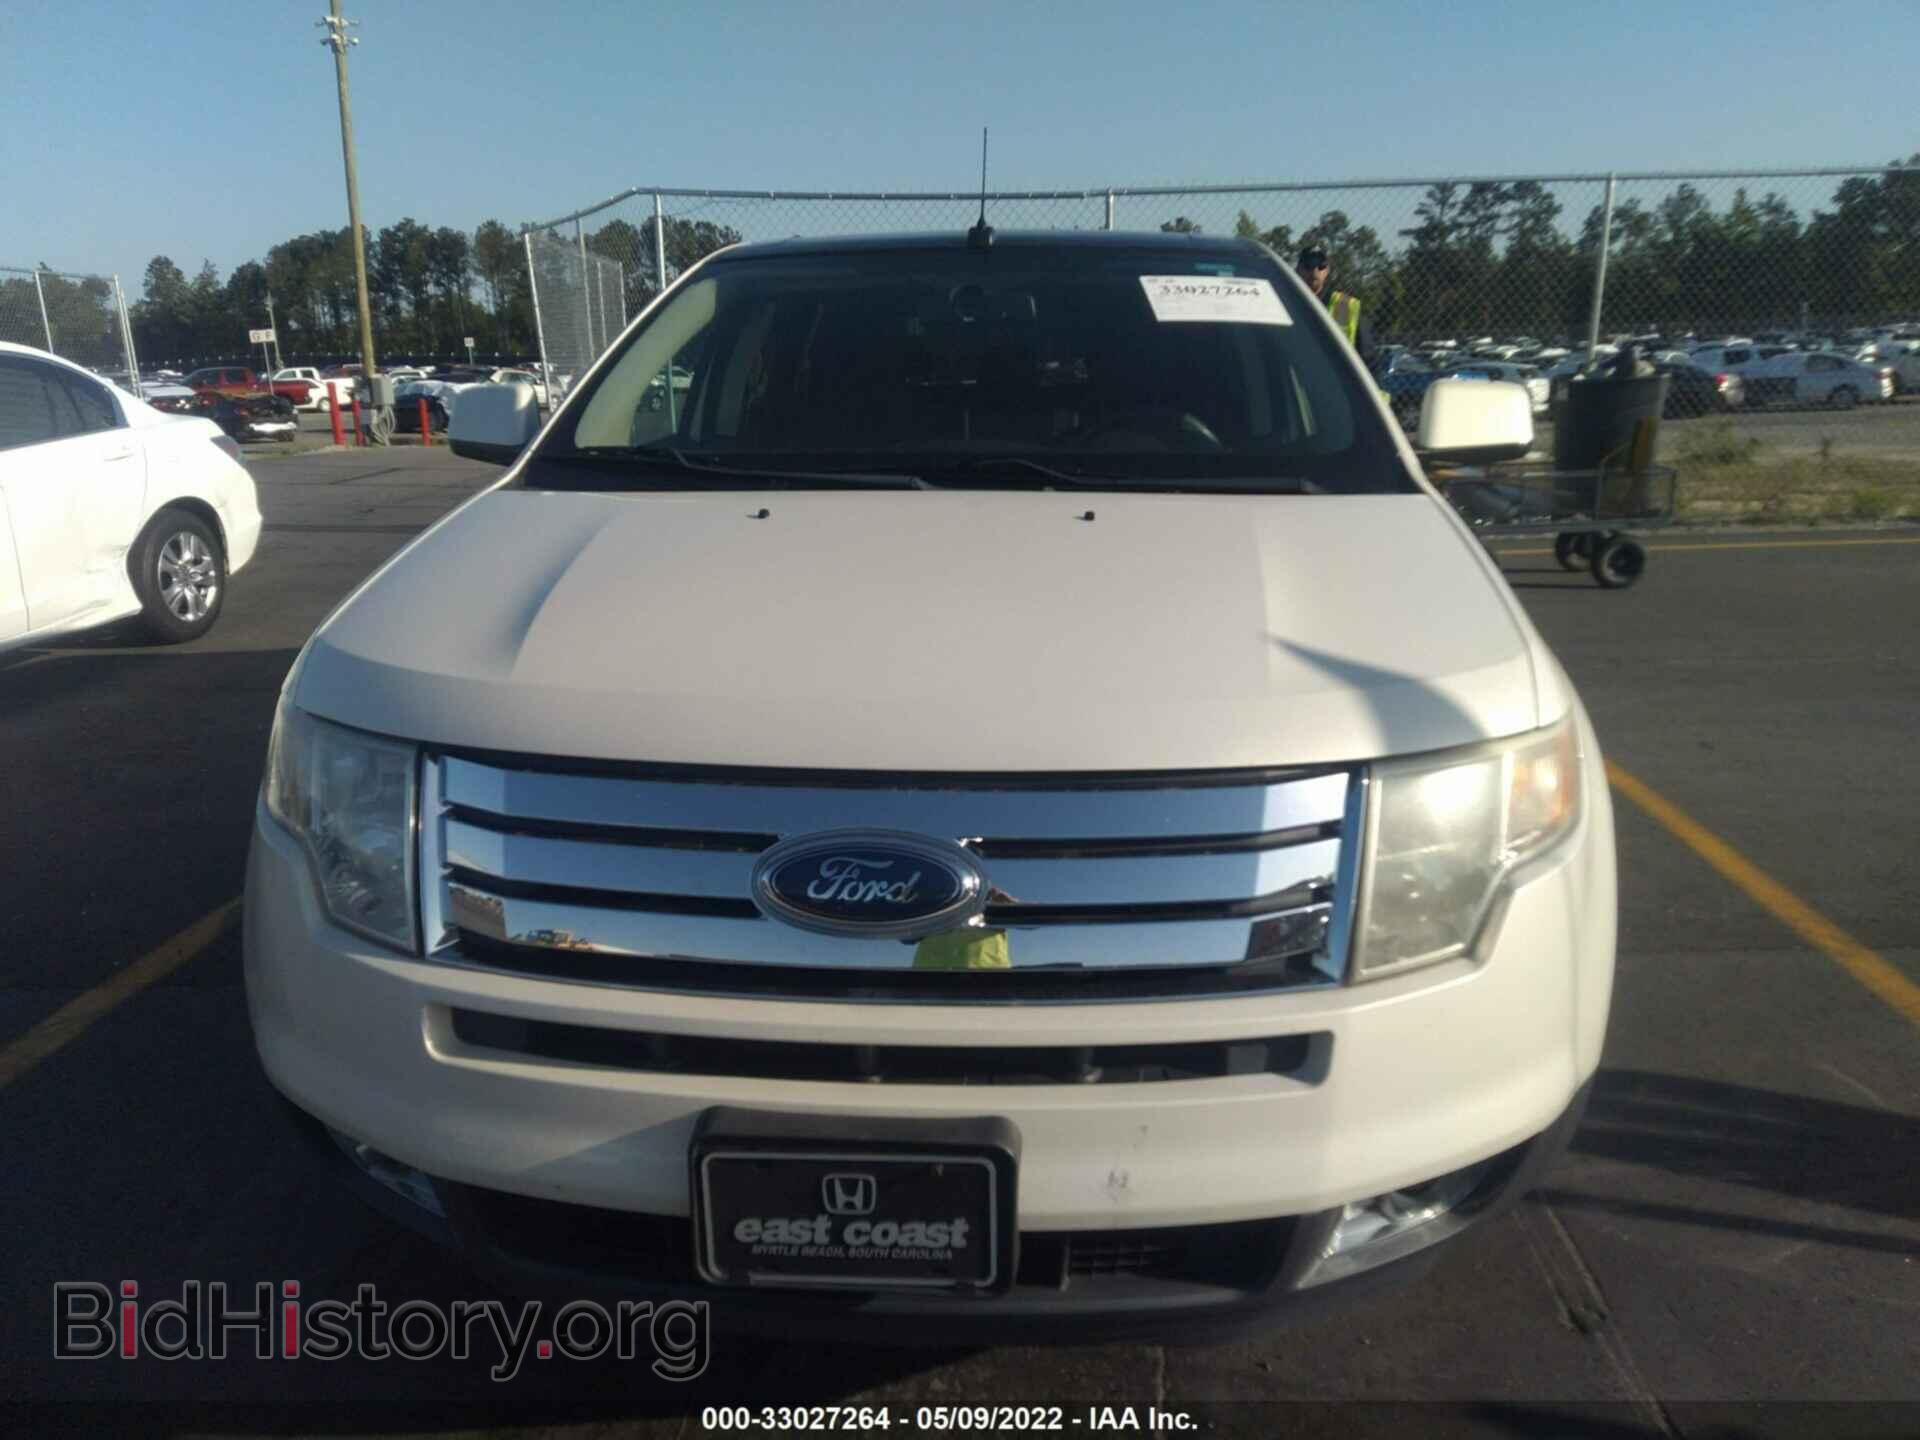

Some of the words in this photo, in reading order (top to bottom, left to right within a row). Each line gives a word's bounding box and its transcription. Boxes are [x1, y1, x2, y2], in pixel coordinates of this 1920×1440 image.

[806, 856, 921, 903] Ford
[733, 1215, 832, 1244] east
[842, 1217, 969, 1249] coast
[847, 1246, 889, 1259] SOUTH
